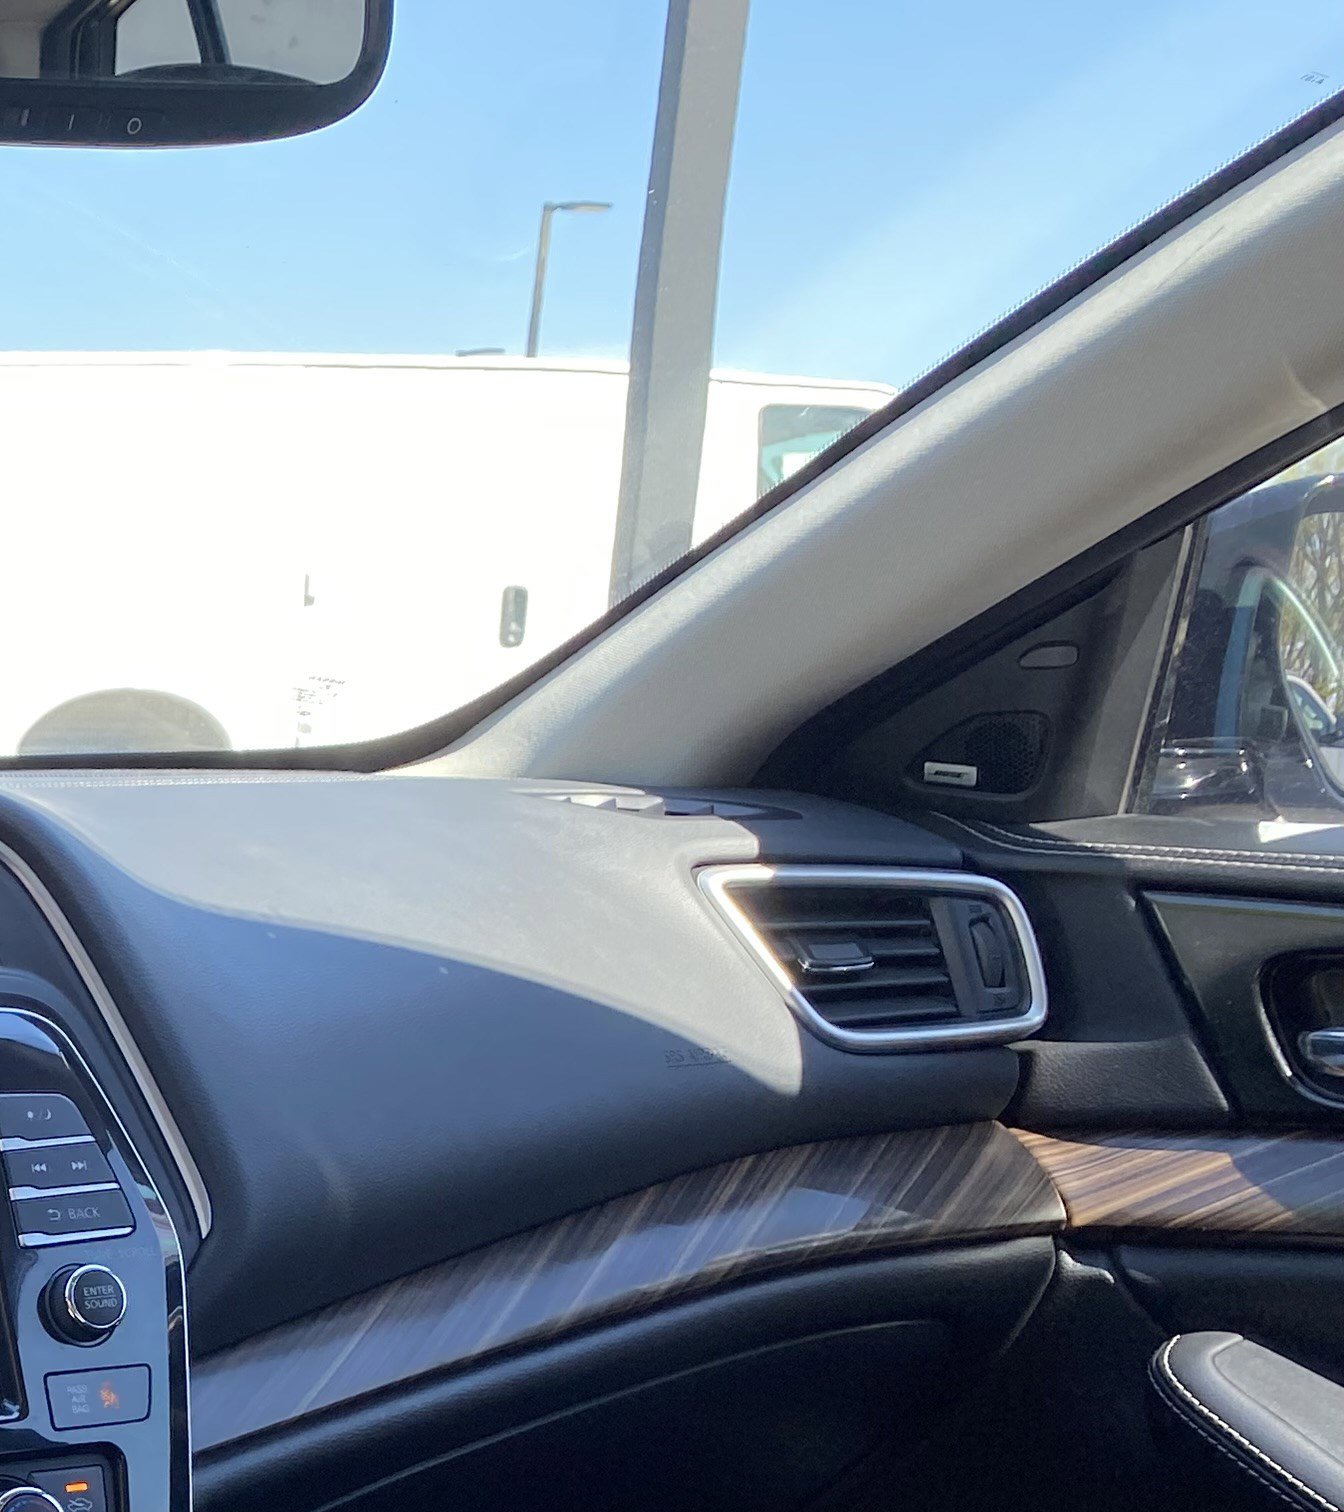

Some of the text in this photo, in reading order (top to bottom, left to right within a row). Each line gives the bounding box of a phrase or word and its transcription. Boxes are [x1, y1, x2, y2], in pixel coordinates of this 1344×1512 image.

[67, 1207, 100, 1219] BACK
[83, 1284, 115, 1297] ENTER
[84, 1298, 118, 1310] SOUND
